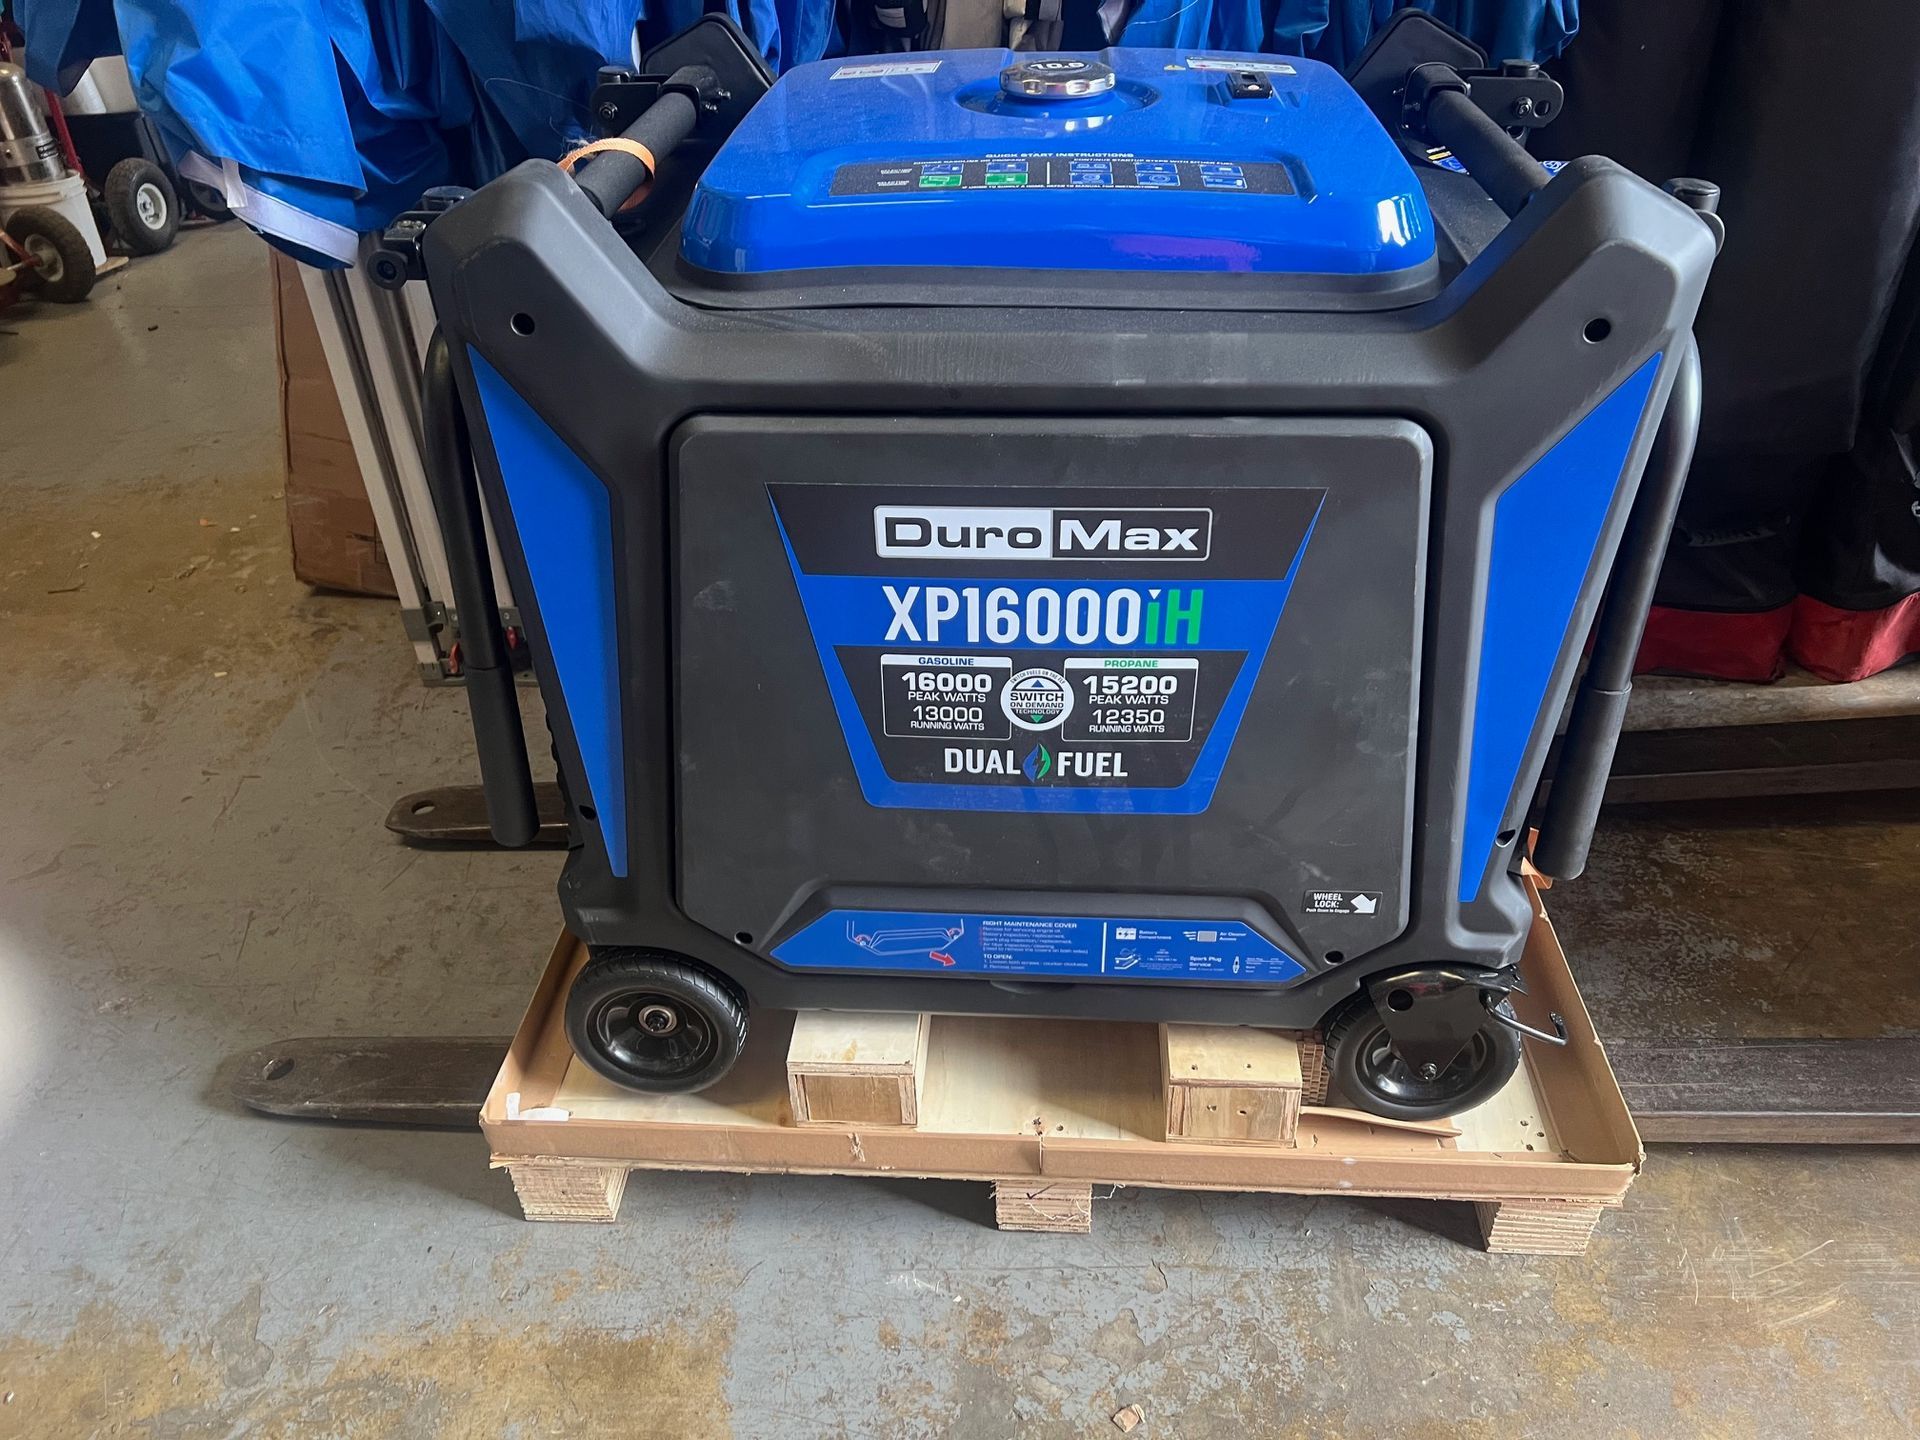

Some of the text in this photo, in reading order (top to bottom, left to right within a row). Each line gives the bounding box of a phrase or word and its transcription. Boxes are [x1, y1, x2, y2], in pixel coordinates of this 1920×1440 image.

[881, 585, 1205, 646] XP16000iH
[918, 656, 975, 666] GASOLINE
[1104, 659, 1159, 668] PROPANE
[901, 671, 992, 693] 16000
[1082, 675, 1178, 695] 15200
[908, 691, 987, 703] PEAK WATTS
[1010, 692, 1064, 701] SWITCH
[1089, 694, 1169, 705] PEAK WATTS
[913, 705, 983, 722] 13000
[1092, 708, 1165, 724] 12350
[910, 720, 985, 731] RUNNING WATTS
[1089, 724, 1165, 733] RUNNING WATTS
[944, 747, 1128, 777] DUAL FUEL
[1313, 892, 1343, 901] WHEEL
[1314, 900, 1340, 909] LOCK:
